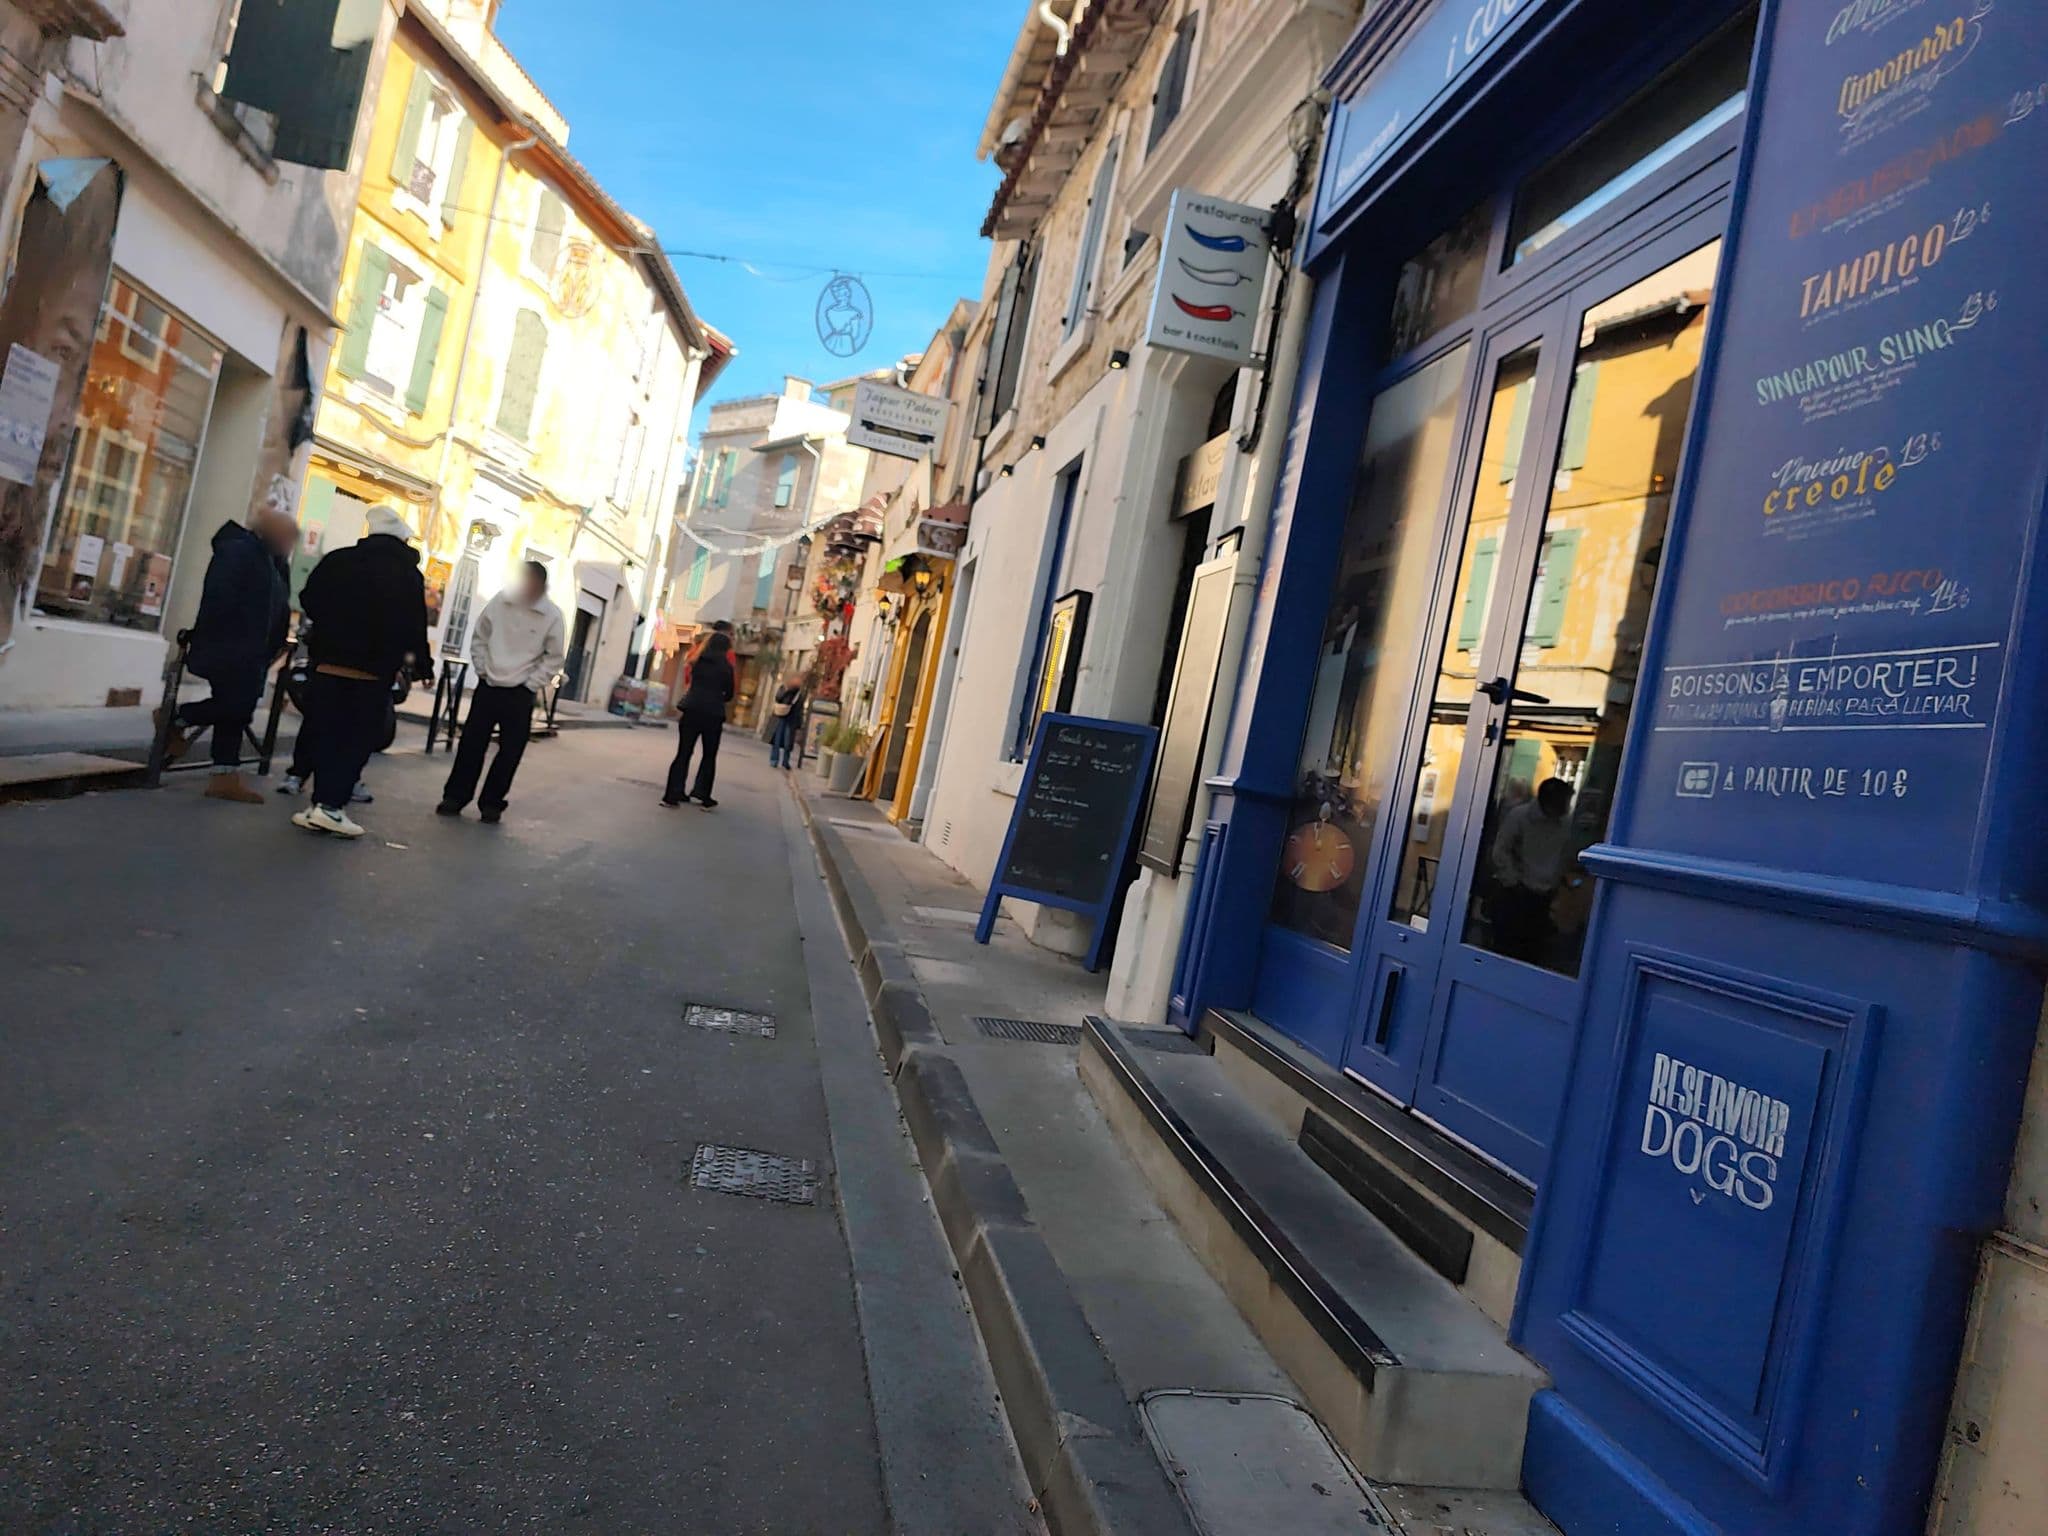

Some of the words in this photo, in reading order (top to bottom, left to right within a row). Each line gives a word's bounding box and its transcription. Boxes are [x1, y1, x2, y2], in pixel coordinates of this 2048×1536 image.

[1800, 224, 1945, 318] TAMPICO
[1757, 346, 1878, 406] SINGAPOUR
[1879, 318, 1976, 366] SLING
[1670, 671, 1768, 698] BOISSONS
[1845, 697, 1899, 717] PARA
[1902, 694, 1974, 718] LLEVAR
[1744, 766, 1816, 799] PARTIR
[1822, 768, 1849, 796] DE
[1650, 1053, 1790, 1158] RESERVOIR
[1641, 1104, 1777, 1211] DOGS
